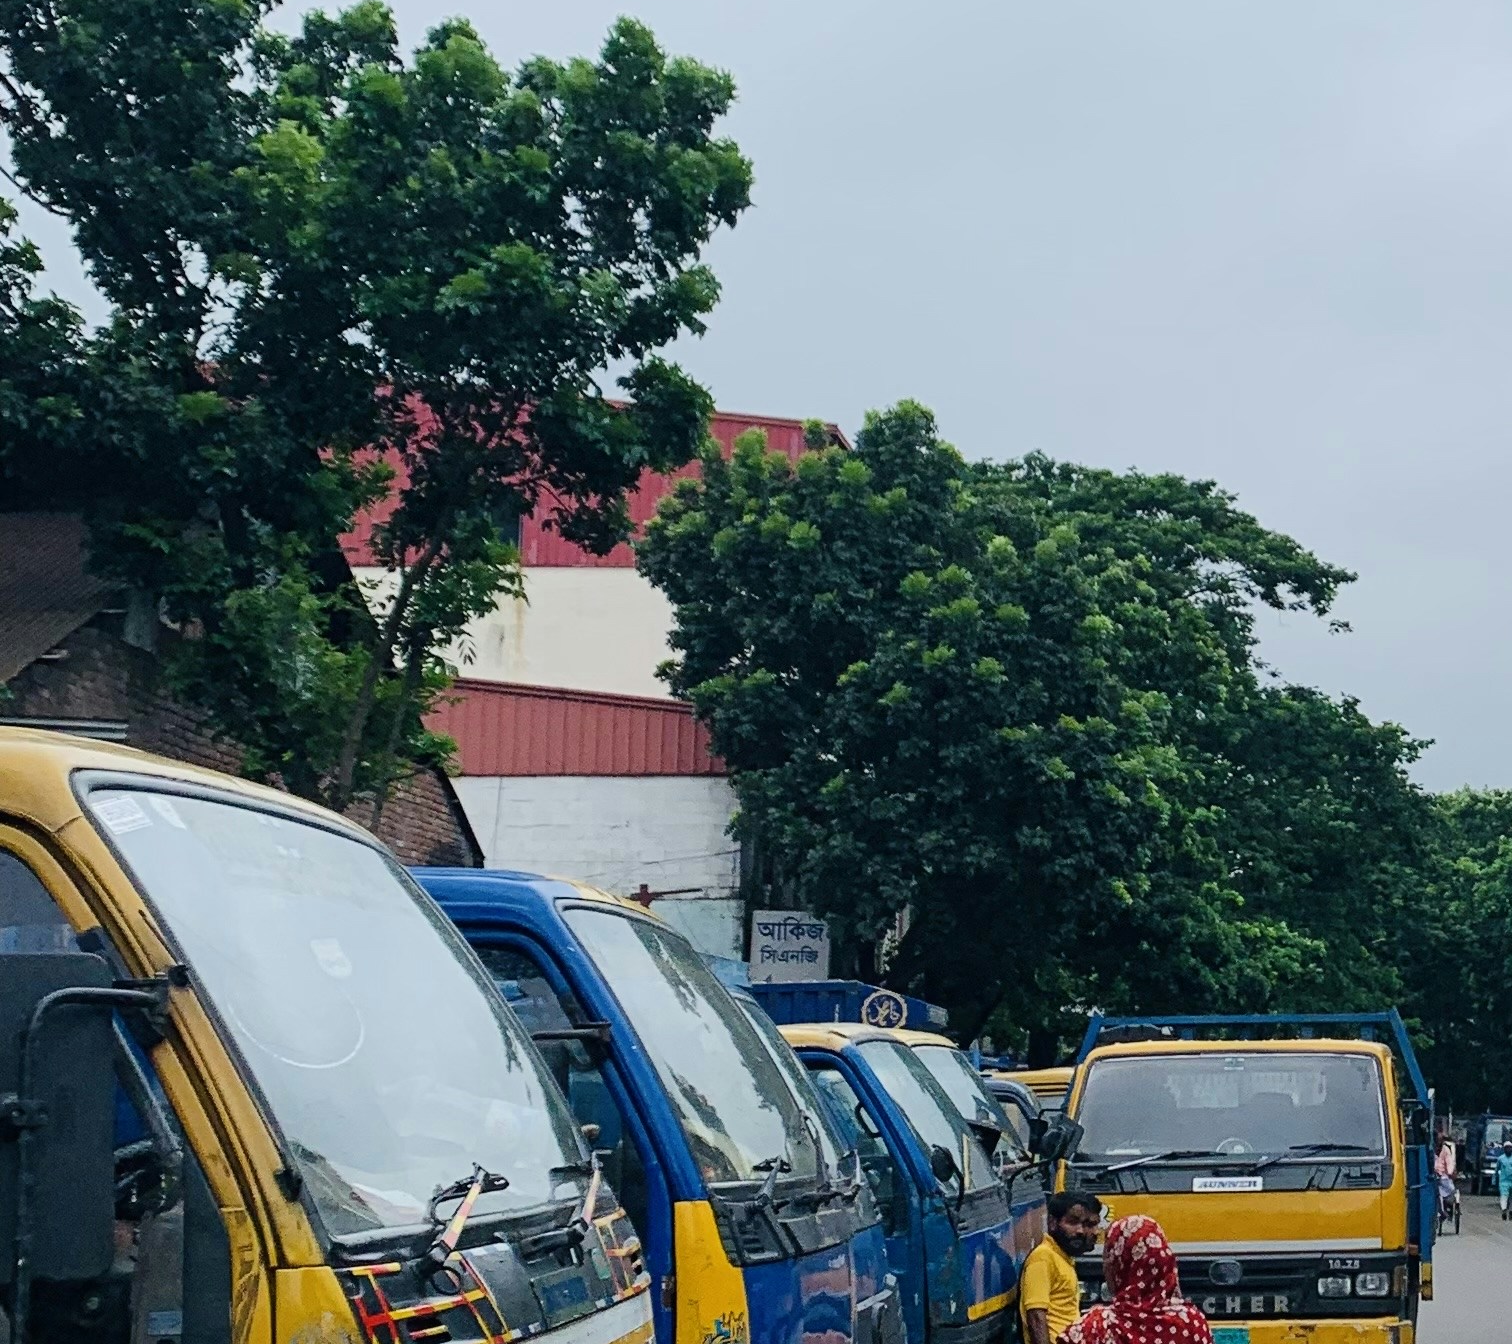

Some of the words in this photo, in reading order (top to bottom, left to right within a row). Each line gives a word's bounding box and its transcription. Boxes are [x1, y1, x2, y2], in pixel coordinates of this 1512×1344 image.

[757, 917, 824, 942] আকিজ
[760, 945, 819, 964] সিএনজি
[1202, 1295, 1290, 1314] CHER
